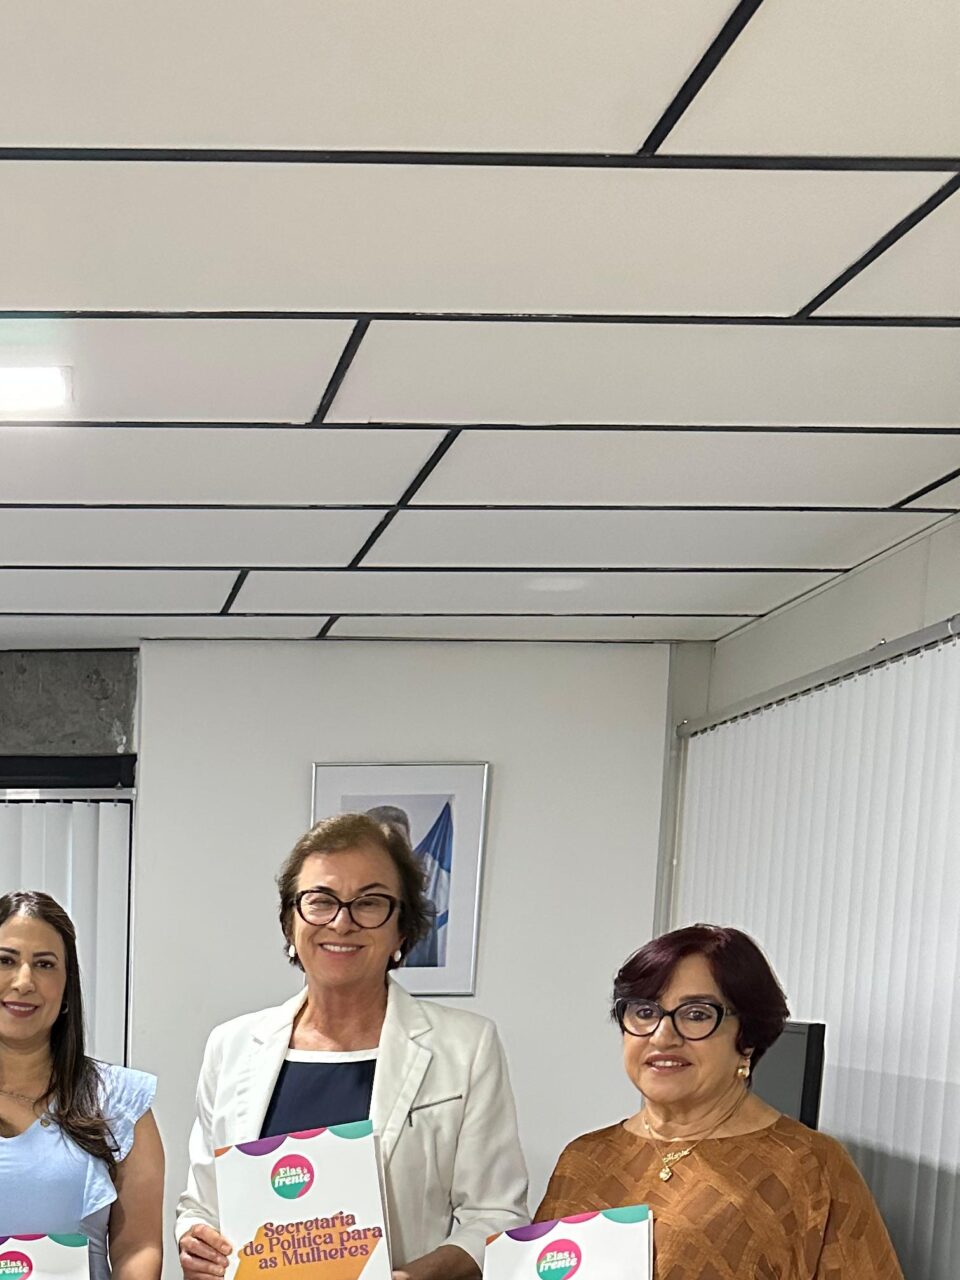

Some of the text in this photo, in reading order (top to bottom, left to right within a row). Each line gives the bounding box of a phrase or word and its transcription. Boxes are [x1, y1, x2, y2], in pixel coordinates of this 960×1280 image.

[279, 1166, 302, 1178] Elas
[275, 1173, 311, 1188] frente
[263, 1211, 356, 1238] Secretaria
[243, 1226, 383, 1257] de Política para
[258, 1243, 369, 1269] as Mulheres
[0, 1260, 22, 1268] Elas
[539, 1257, 578, 1272] frente
